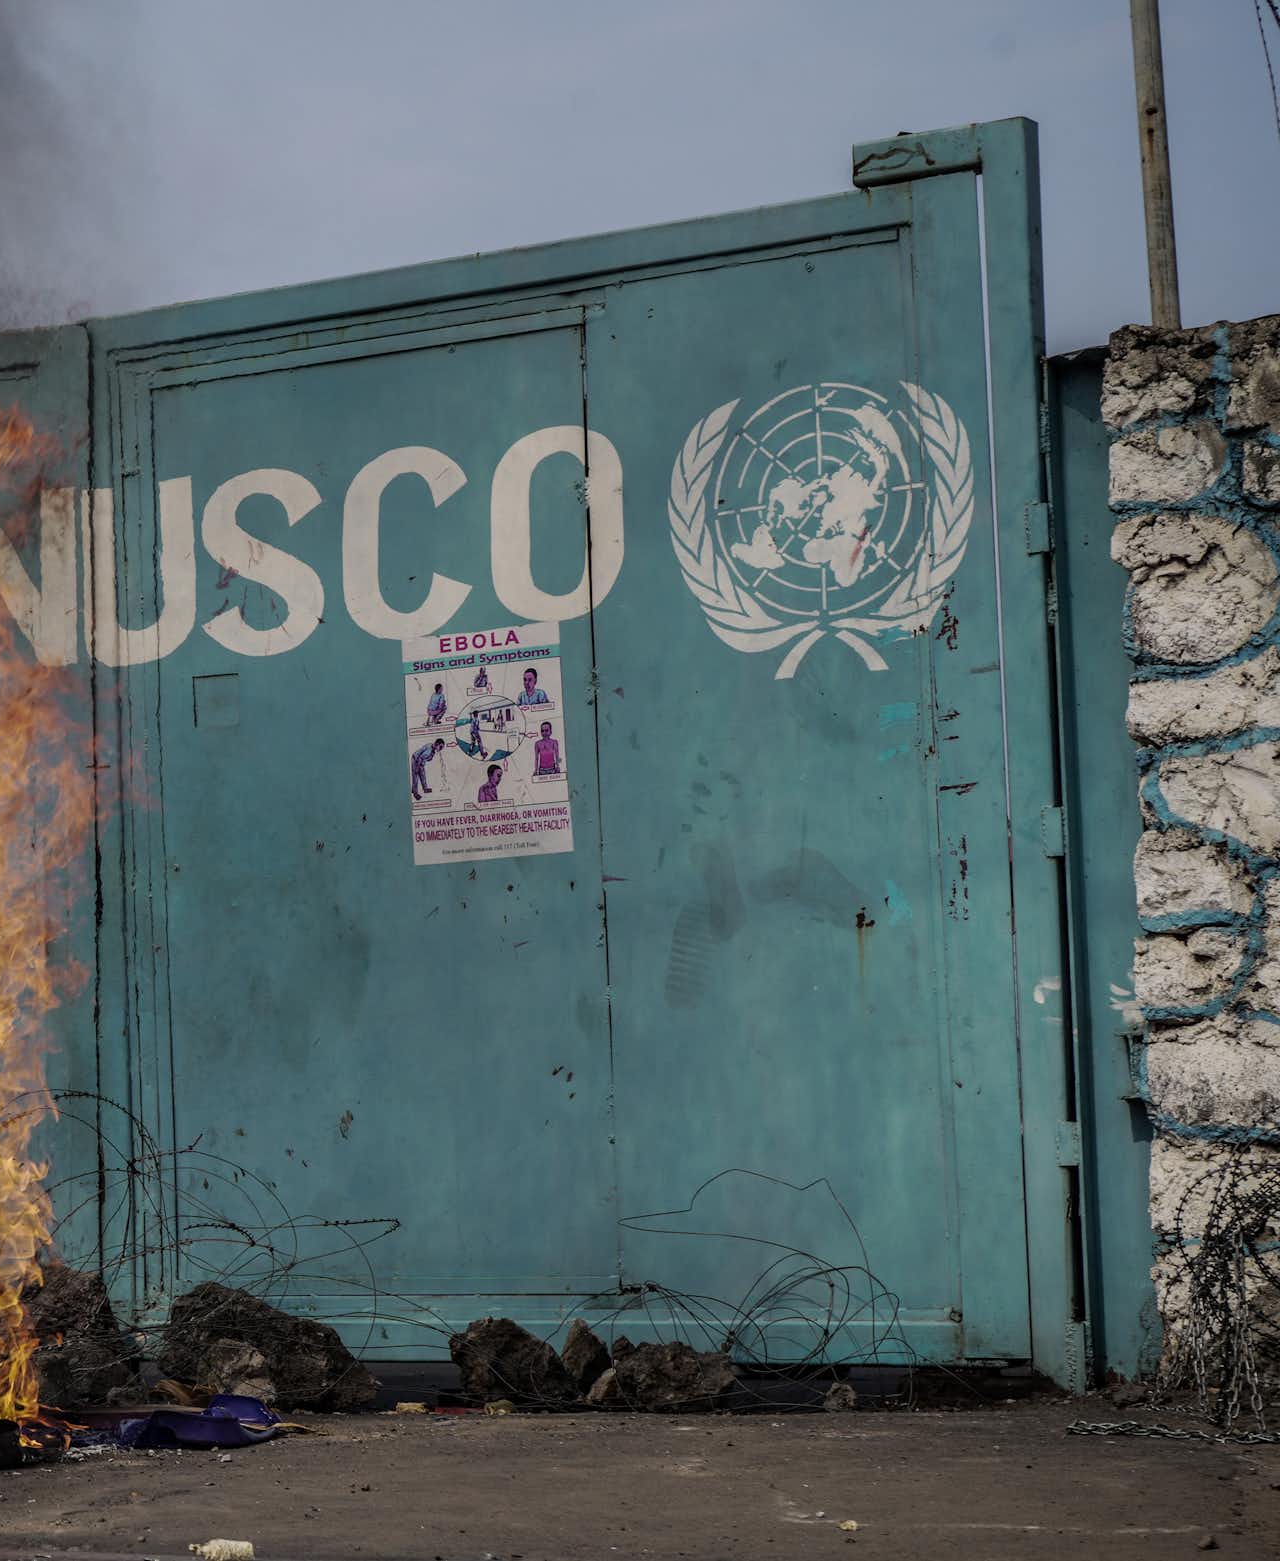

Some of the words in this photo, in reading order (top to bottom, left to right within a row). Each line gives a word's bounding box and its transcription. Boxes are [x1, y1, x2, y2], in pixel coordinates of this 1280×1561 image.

[439, 630, 520, 653] EBOLA
[413, 661, 445, 671] Signs
[448, 654, 475, 666] and
[479, 647, 551, 666] Symptoms
[422, 818, 435, 828] YOU
[436, 815, 454, 826] HAVE
[455, 814, 478, 825] FEVER,
[522, 810, 533, 819] OR
[533, 806, 568, 818] VOMITING
[415, 831, 425, 842] GO
[426, 827, 466, 842] IMMEDIATELY
[466, 827, 475, 837] TO
[476, 825, 488, 837] THE
[489, 822, 518, 836] NEAREST
[519, 820, 543, 833] HEALTH
[543, 818, 570, 831] FACILITY
